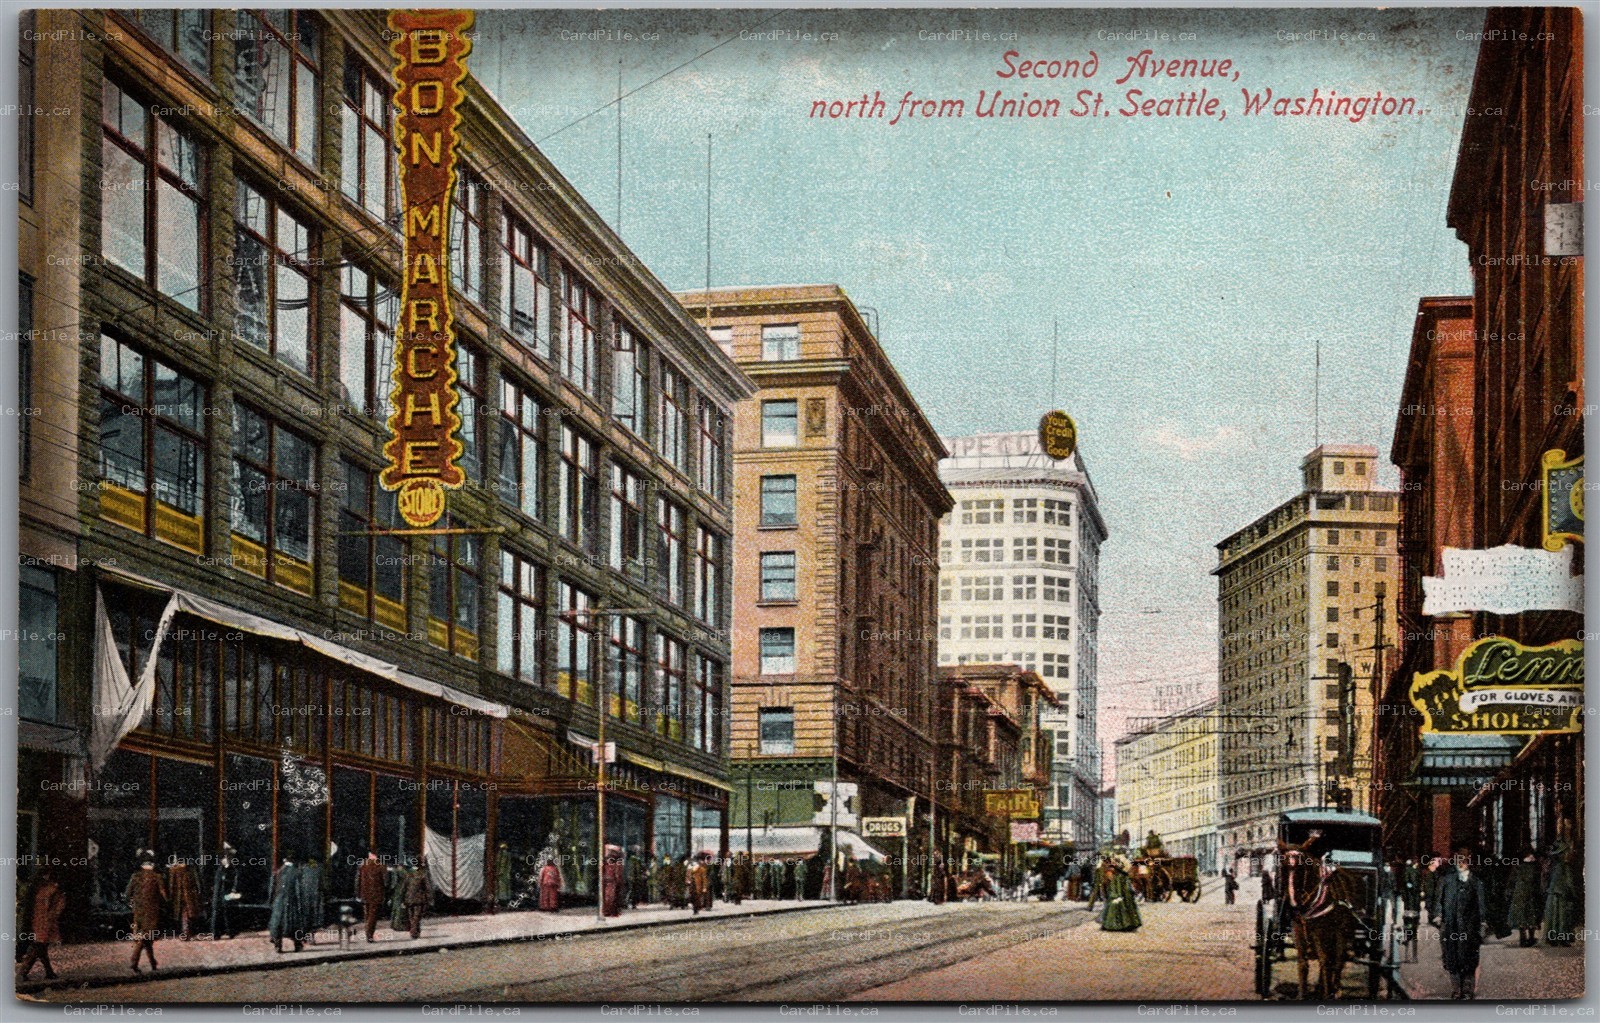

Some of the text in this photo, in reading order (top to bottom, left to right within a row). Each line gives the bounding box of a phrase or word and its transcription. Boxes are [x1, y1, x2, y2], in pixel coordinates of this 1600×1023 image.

[404, 29, 448, 474] BON MARCHE
[1047, 415, 1068, 426] Your
[1046, 425, 1073, 438] Credit
[1047, 445, 1069, 456] Good
[1471, 693, 1497, 704] FOR
[1504, 691, 1555, 702] GLOVES
[1451, 711, 1550, 730] SHOES
[868, 822, 901, 832] DRUGS
